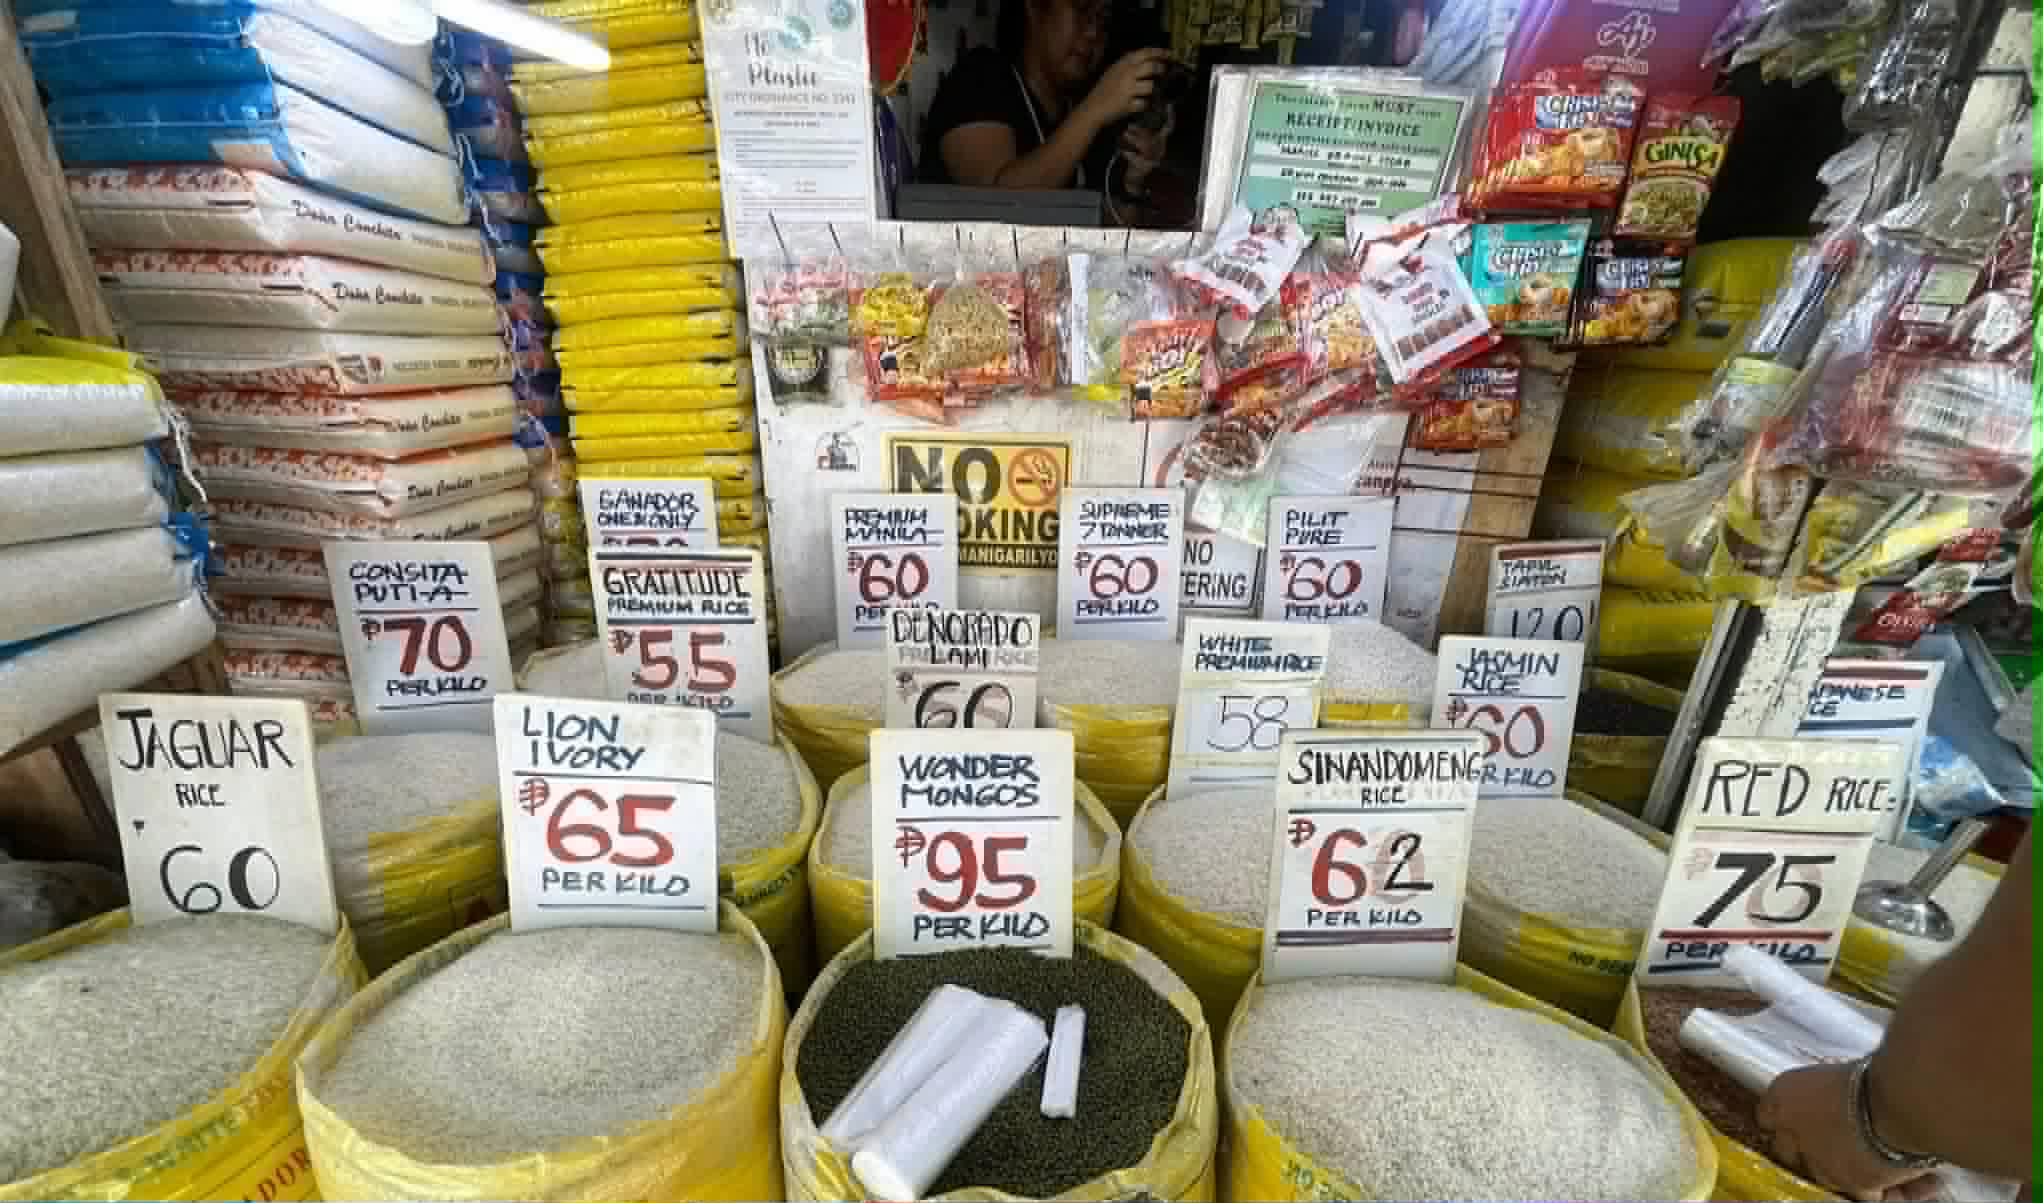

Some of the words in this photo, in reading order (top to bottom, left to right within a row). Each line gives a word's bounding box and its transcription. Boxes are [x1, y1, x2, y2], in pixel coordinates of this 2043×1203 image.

[1286, 111, 1421, 137] RECEIPT/INVOICE
[895, 446, 1000, 505] NO
[599, 489, 699, 512] GANADOR
[1080, 501, 1169, 520] SUPREME
[845, 508, 928, 527] PREMIUM
[958, 508, 1059, 542] OKING
[1286, 509, 1350, 528] PILIT
[1080, 521, 1097, 541] 7
[1285, 528, 1345, 546] PURE
[1184, 539, 1214, 566] NO
[349, 560, 469, 585] CONSITA
[602, 567, 752, 598] GRATITUDE
[1182, 571, 1248, 600] ERING
[607, 598, 694, 615] PREMIUM
[701, 599, 750, 616] RICE
[1199, 634, 1273, 652] WHITE
[1194, 653, 1281, 672] PREMIUM
[1458, 648, 1560, 677] JASMIN
[1462, 670, 1523, 692] RICE
[522, 706, 620, 742] LION
[1207, 694, 1289, 752] 58
[115, 708, 296, 771] JAGUAR
[531, 740, 646, 771] IVORY
[899, 754, 1041, 783] WONDER
[1287, 748, 1485, 785] SINANDOMENG
[174, 783, 225, 809] RICE
[901, 783, 1041, 809] MONGOS
[1360, 785, 1408, 808] RICE
[1701, 759, 1811, 817] RED
[1824, 775, 1892, 814] RICE
[159, 845, 281, 915] 60
[541, 867, 606, 892] PER
[615, 872, 691, 897] KILO
[913, 914, 975, 942] PER
[980, 912, 1050, 940] KILO
[1306, 909, 1361, 928] PER
[1368, 908, 1423, 926] KILO
[1757, 941, 1817, 962] ILO
